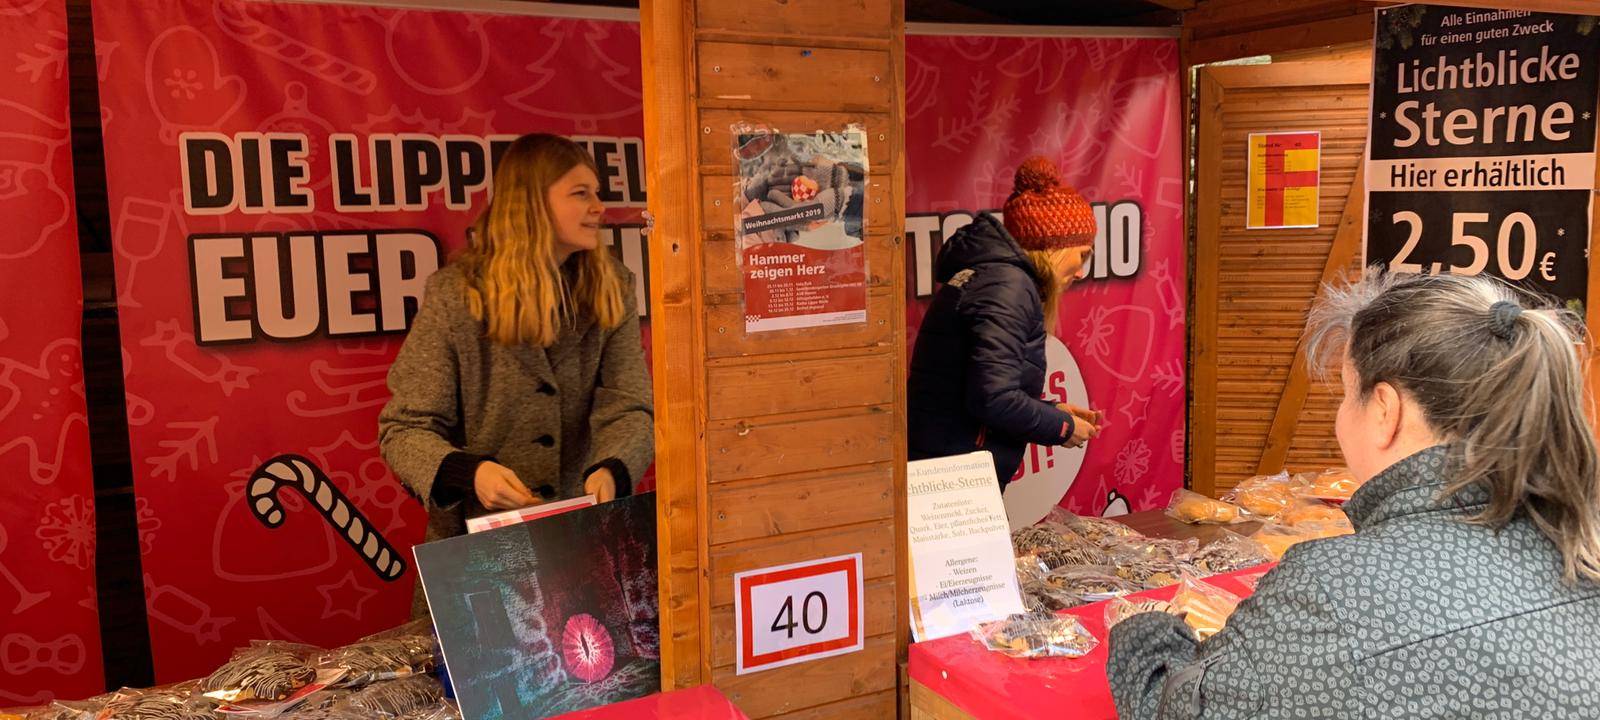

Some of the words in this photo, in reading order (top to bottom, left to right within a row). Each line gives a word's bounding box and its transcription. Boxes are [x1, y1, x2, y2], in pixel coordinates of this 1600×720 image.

[1440, 15, 1463, 27] Alle
[1466, 9, 1532, 25] Einnahmen
[1421, 34, 1437, 46] für
[1440, 32, 1472, 45] einen
[1475, 27, 1509, 44] guten
[1512, 20, 1554, 36] Zweck
[1397, 45, 1580, 94] Lichtblicke
[1393, 100, 1574, 148] Sterne
[180, 133, 314, 214] DIE
[330, 134, 647, 213] LIPPEL
[1391, 163, 1437, 188] Hier
[1444, 158, 1566, 187] erhältlich
[745, 213, 804, 230] Weihnachtsmarkt
[805, 209, 821, 218] 2019
[749, 253, 805, 266] Hammer
[750, 267, 793, 280] zeigen
[797, 264, 825, 275] Herz
[191, 230, 439, 344] EUER
[916, 461, 990, 477] Kundeninformation
[939, 574, 993, 589] Ei/Eierzeugnisse
[953, 567, 977, 576] Weizen
[929, 582, 1006, 602] Milch/Milcherzeugnisse
[952, 595, 984, 608] (Laktose)
[770, 590, 828, 639] 40
